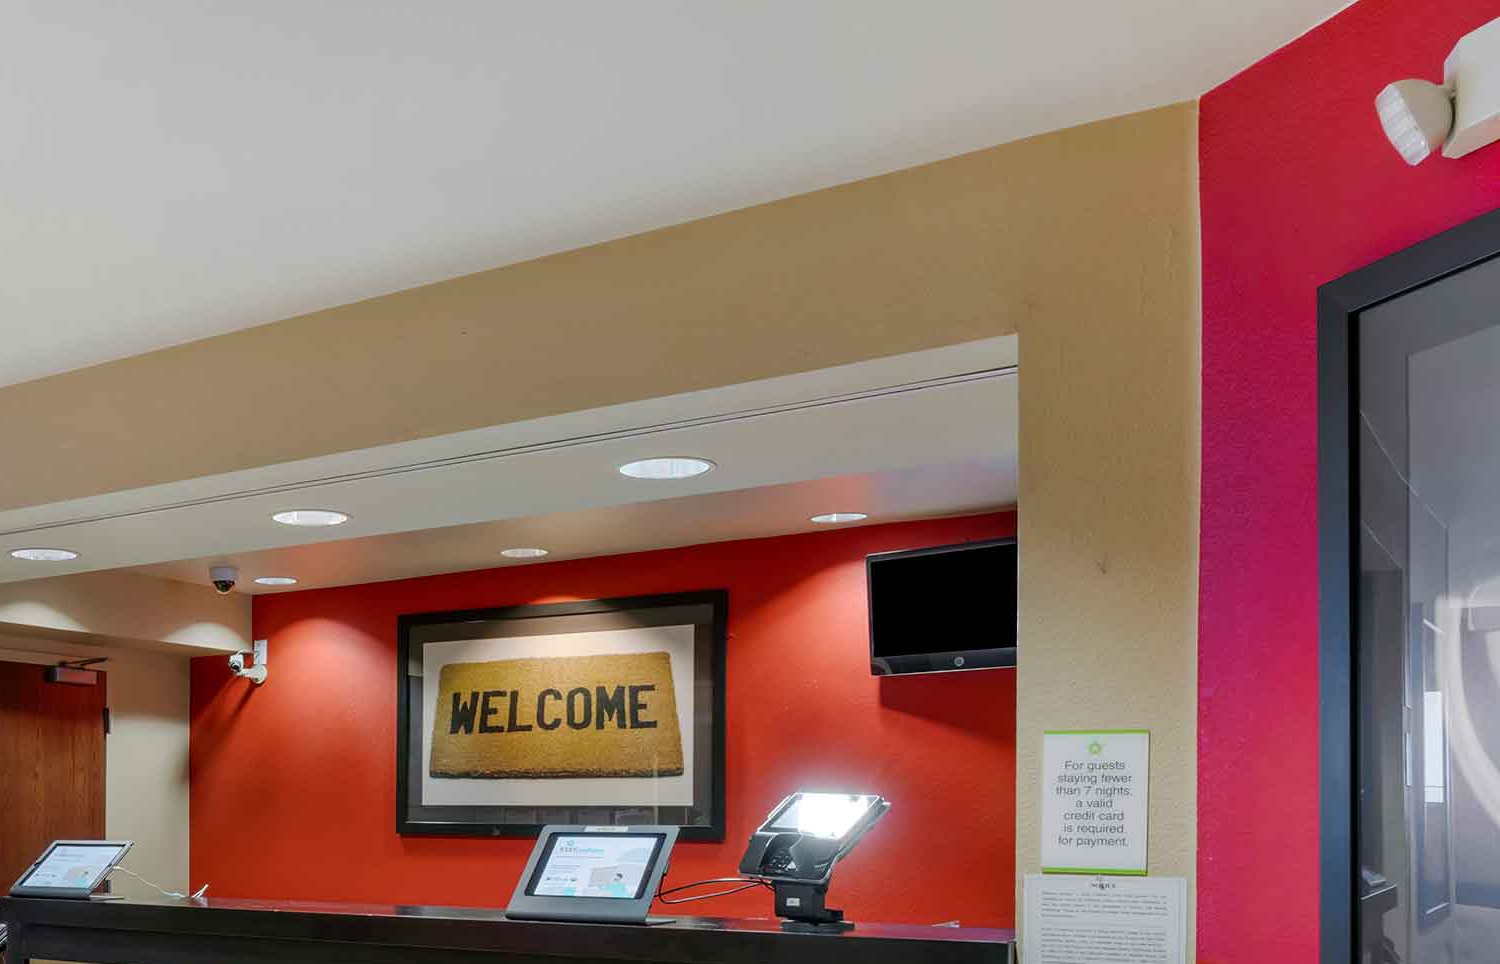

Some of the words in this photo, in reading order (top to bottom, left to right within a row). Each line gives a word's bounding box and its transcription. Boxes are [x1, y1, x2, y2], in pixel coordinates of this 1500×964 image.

[450, 685, 658, 735] WELCOME
[1064, 760, 1084, 770] For
[1087, 761, 1125, 773] guests
[1058, 774, 1098, 785] staying
[1101, 774, 1132, 783] fewer
[1056, 786, 1080, 796] than
[1084, 786, 1092, 795] 7
[1075, 800, 1083, 808] a
[1087, 799, 1113, 808] valid
[1063, 811, 1095, 821] credit
[1098, 812, 1125, 821] card
[1064, 824, 1073, 833] is
[1076, 824, 1124, 835] required
[1058, 836, 1073, 846] for
